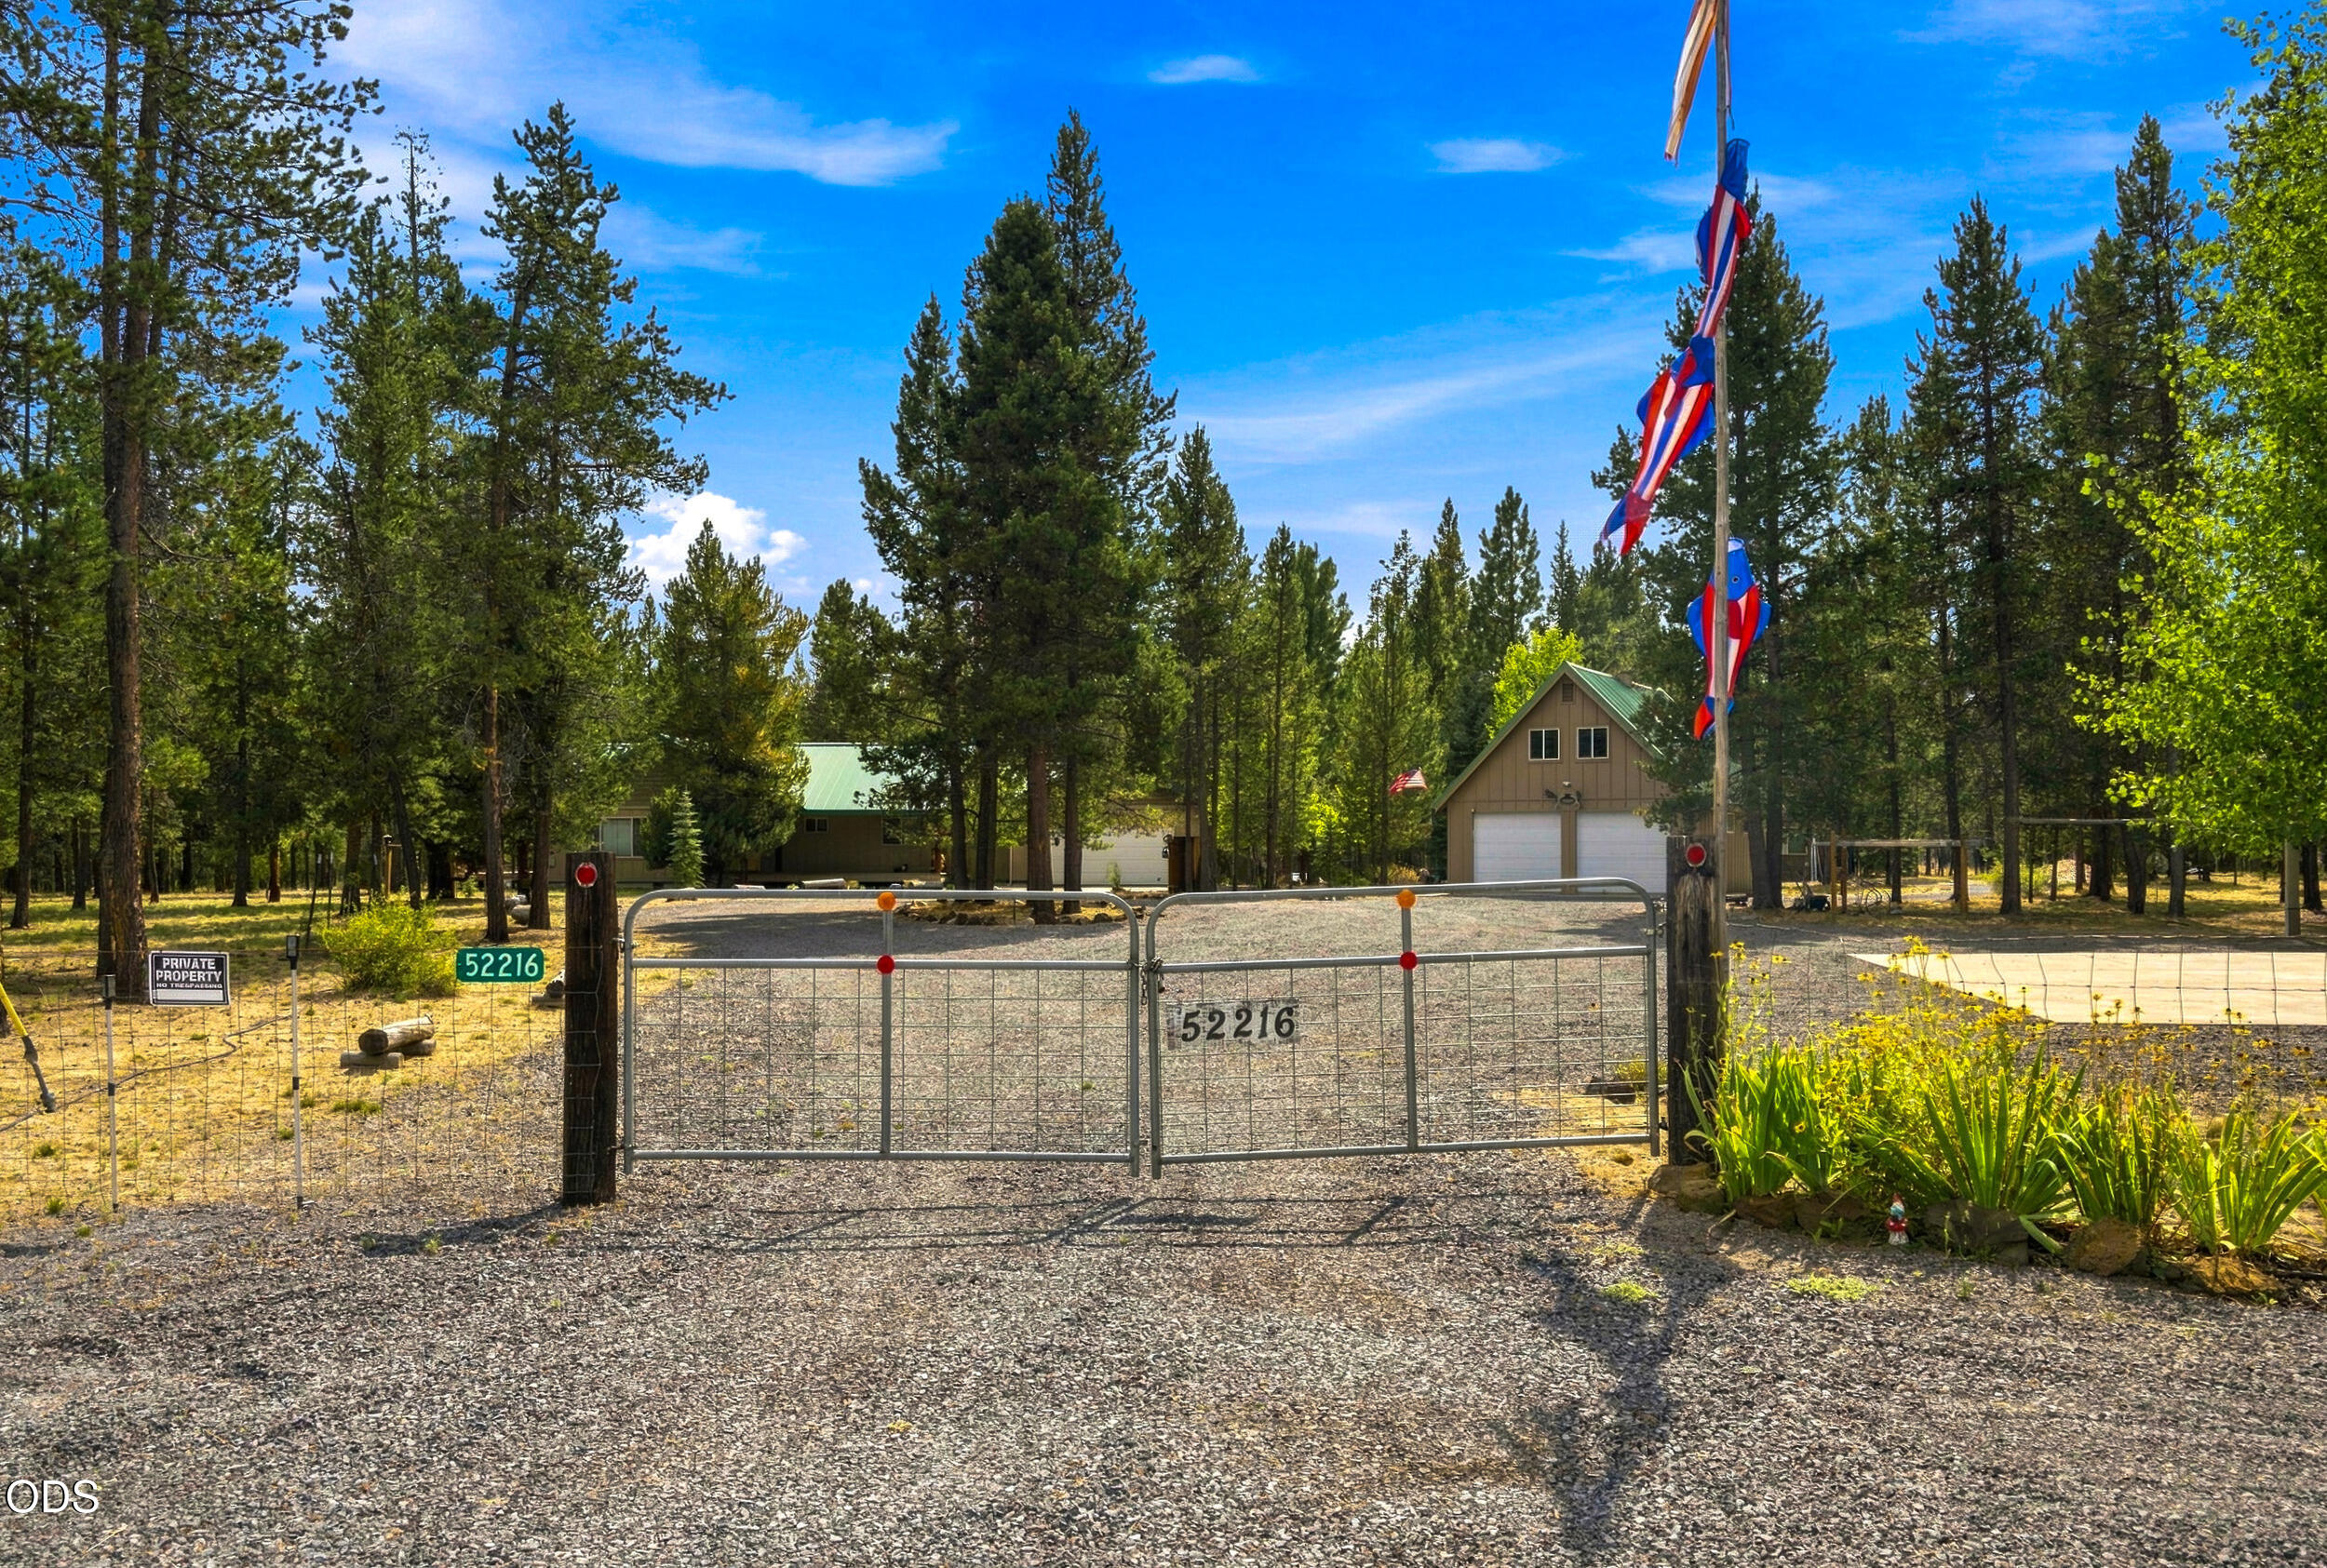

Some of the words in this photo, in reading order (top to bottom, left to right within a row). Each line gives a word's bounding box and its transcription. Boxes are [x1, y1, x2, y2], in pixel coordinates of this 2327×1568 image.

[162, 958, 216, 970] PRIVATE
[465, 952, 539, 977] 52216
[155, 970, 222, 982] PROPERTY
[1181, 1006, 1296, 1042] 52216
